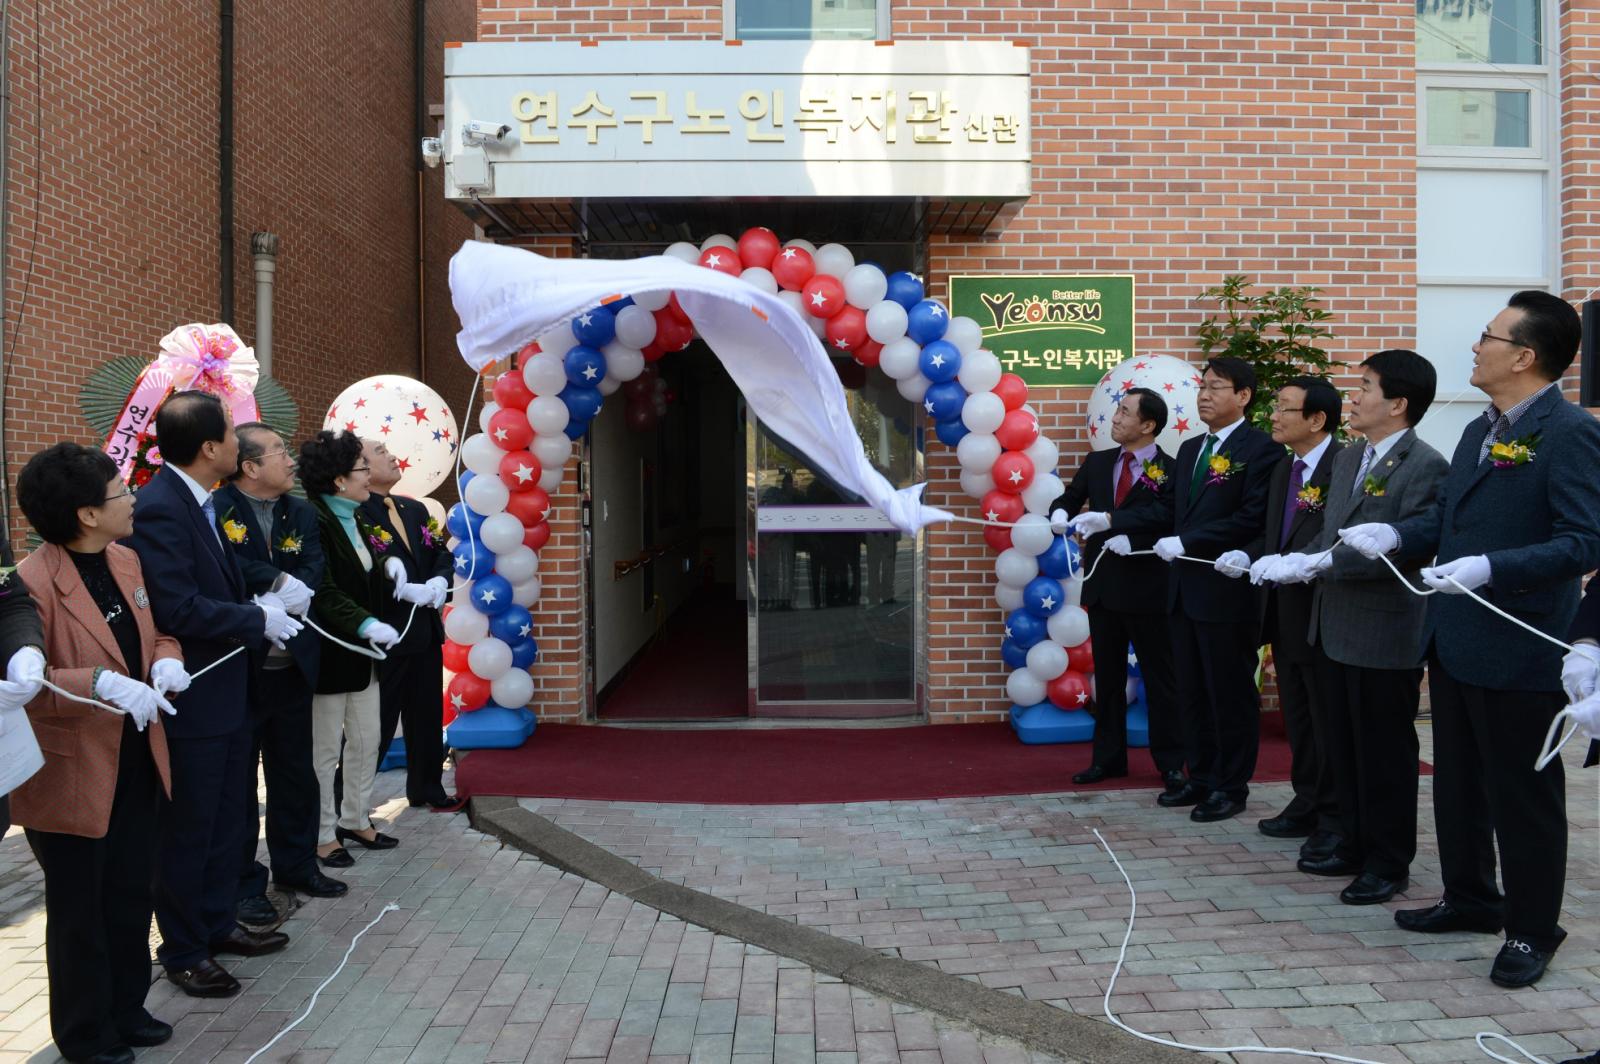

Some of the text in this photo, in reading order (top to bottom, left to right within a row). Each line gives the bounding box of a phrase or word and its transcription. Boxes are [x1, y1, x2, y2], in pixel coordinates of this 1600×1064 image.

[511, 89, 1020, 146] 연수구노인복지관 신관
[1052, 289, 1101, 300] Better life
[980, 292, 1102, 331] Yeonsu
[989, 348, 1125, 371] 구노인복지관
